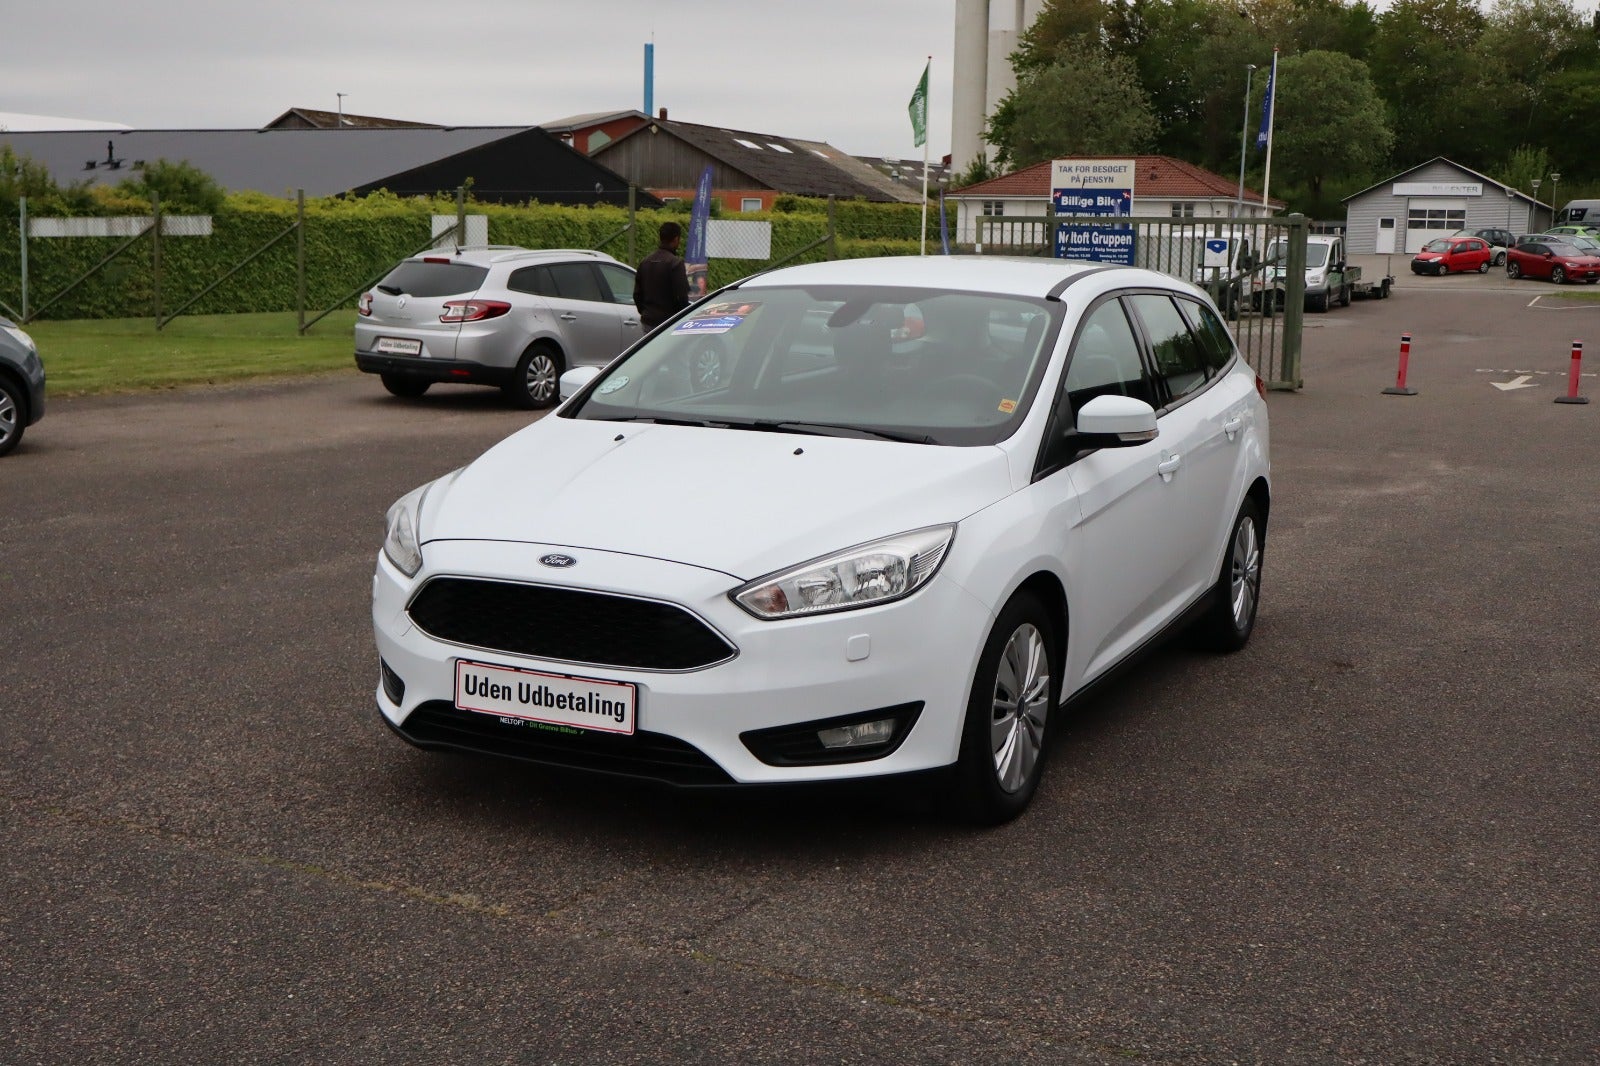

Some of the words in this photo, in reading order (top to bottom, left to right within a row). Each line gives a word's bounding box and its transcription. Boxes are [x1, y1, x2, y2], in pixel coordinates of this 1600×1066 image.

[1093, 165, 1128, 173] BESØGET
[1071, 175, 1081, 183] PÅ
[1092, 232, 1132, 247] Gruppen
[544, 555, 570, 565] Ford
[465, 674, 512, 701] Uden
[518, 682, 625, 723] Udbetaling
